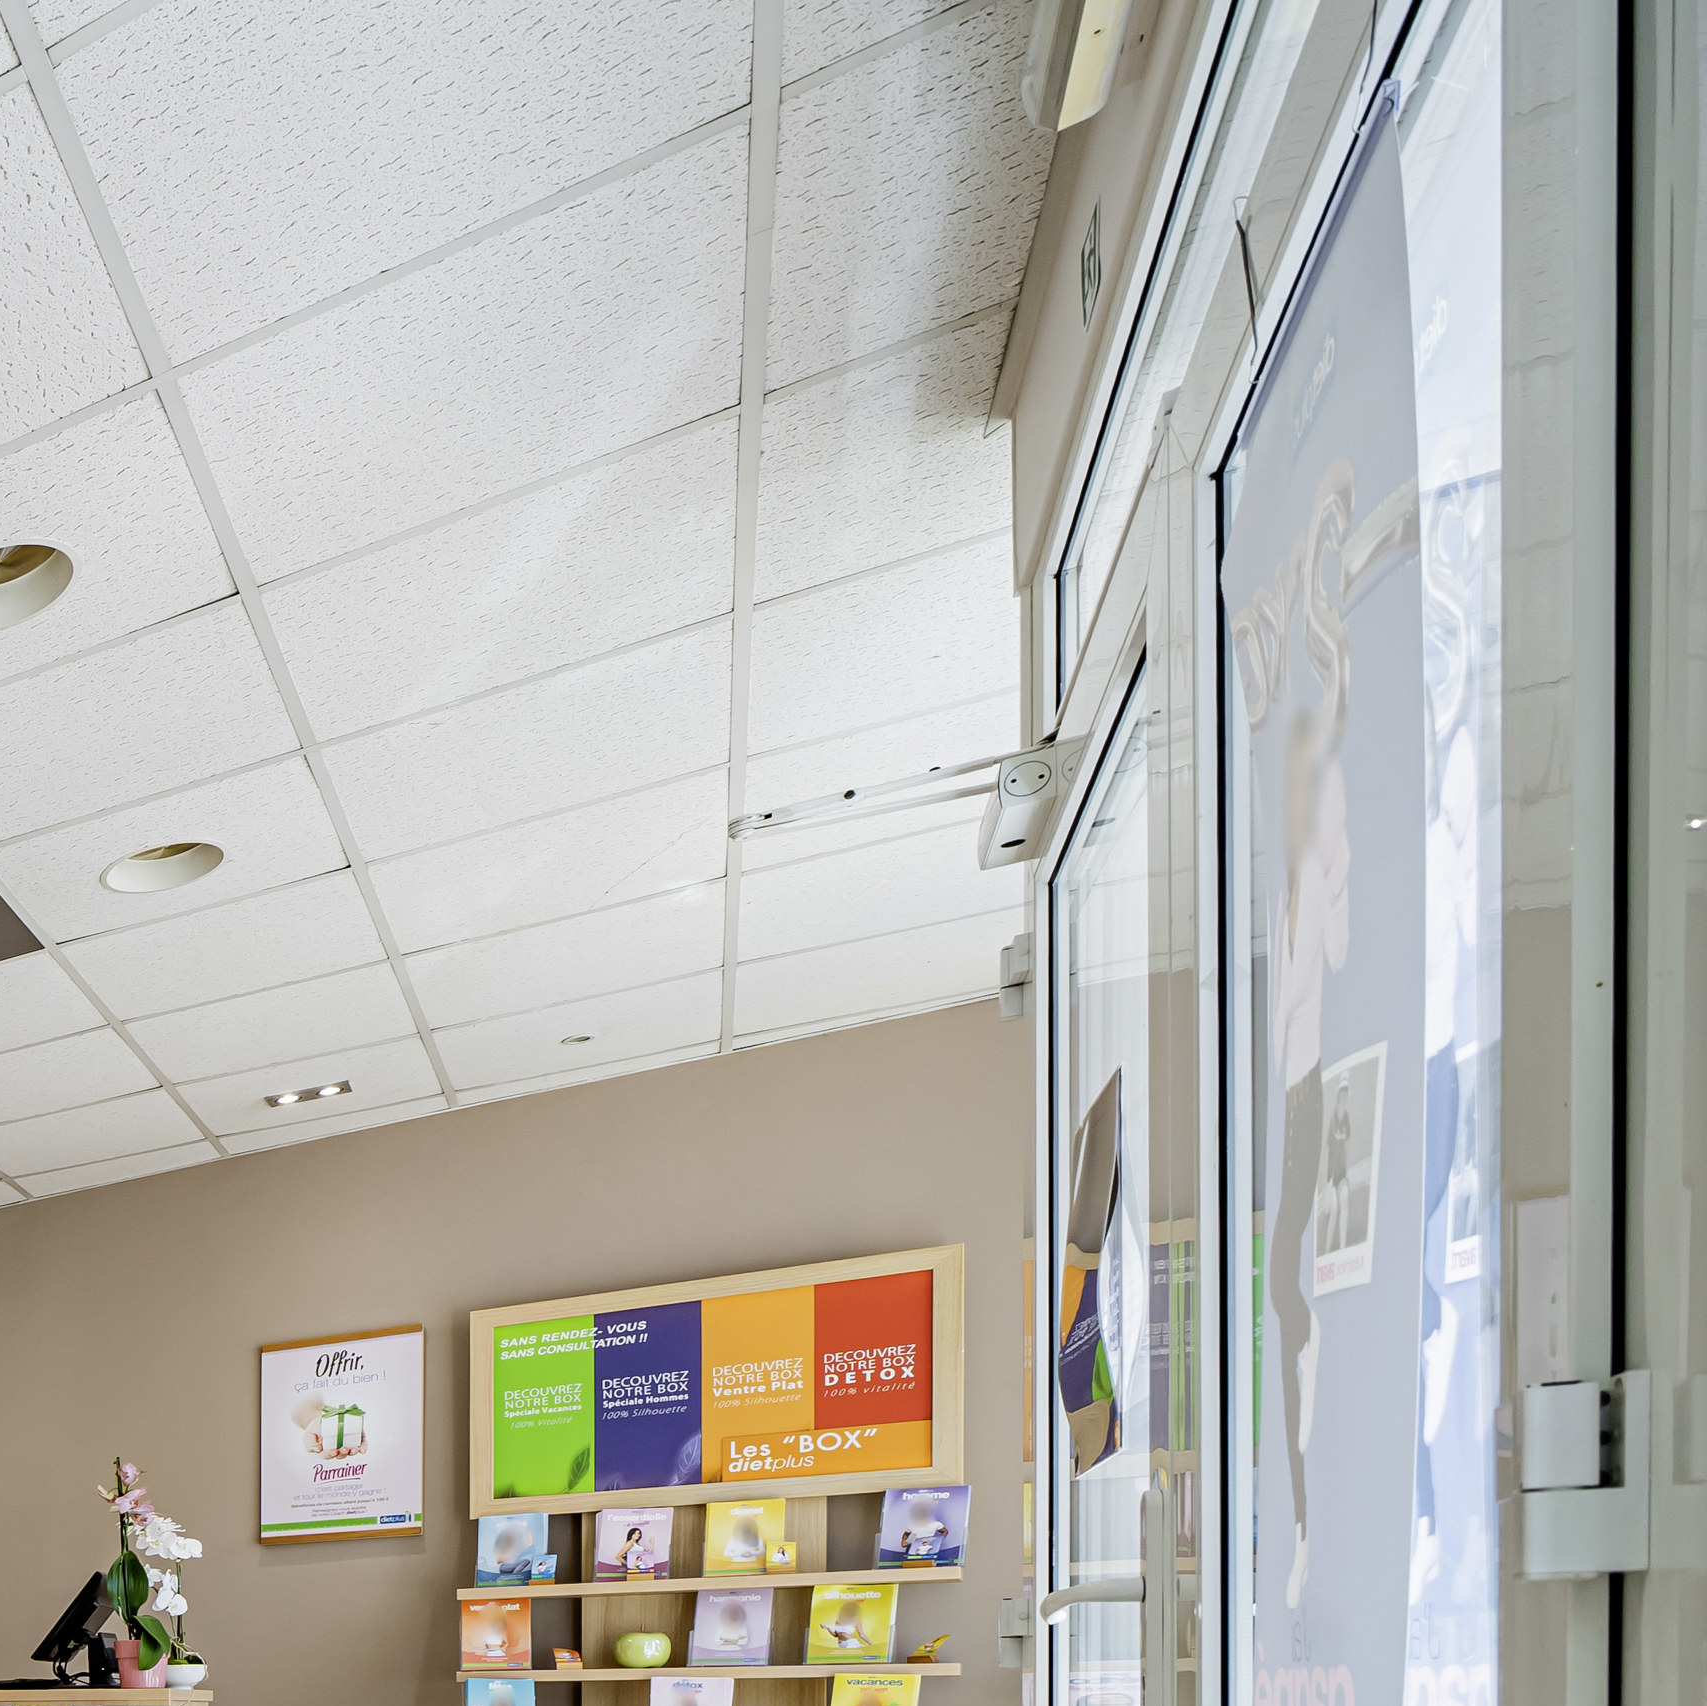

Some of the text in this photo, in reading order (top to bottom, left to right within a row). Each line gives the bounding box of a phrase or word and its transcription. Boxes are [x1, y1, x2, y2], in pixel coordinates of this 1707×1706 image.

[500, 1335, 537, 1348] SANS
[607, 1320, 647, 1335] VOUS
[500, 1347, 535, 1361] SANS
[537, 1334, 637, 1356] CONSULTATION
[823, 1343, 916, 1364] DECOUVREZ
[315, 1350, 364, 1378] Offrir,
[712, 1357, 803, 1377] DECOUVREZ
[824, 1355, 915, 1374] NOTRE BOX
[294, 1381, 309, 1393] ça
[312, 1378, 329, 1389] fait
[332, 1376, 349, 1387] du
[353, 1372, 379, 1385] bien
[602, 1370, 689, 1390] DECOUVREZ
[713, 1368, 803, 1387] NOTRE BOX
[824, 1366, 915, 1387] DETOX
[504, 1383, 583, 1401] DECOUVREZ
[602, 1380, 688, 1399] NOTRE BOX
[712, 1380, 804, 1397] Ventre Plat
[823, 1381, 916, 1398] 100% vitalité
[504, 1393, 582, 1410] NOTRE BOX
[602, 1393, 689, 1409] Spéciale Hommes
[713, 1394, 801, 1409] 100% Silhouette
[504, 1404, 582, 1419] Spéciale Vacances
[602, 1404, 688, 1420] 100% Silhouette
[511, 1416, 573, 1429] 100% Vitalité
[730, 1441, 771, 1459] Les
[313, 1462, 368, 1483] Parrainer
[728, 1454, 815, 1473] dietplus
[902, 1491, 950, 1500] home
[381, 1515, 405, 1523] dietplus
[709, 1592, 761, 1603] haronie
[823, 1590, 881, 1601] silhouette
[846, 1678, 903, 1687] vacances
